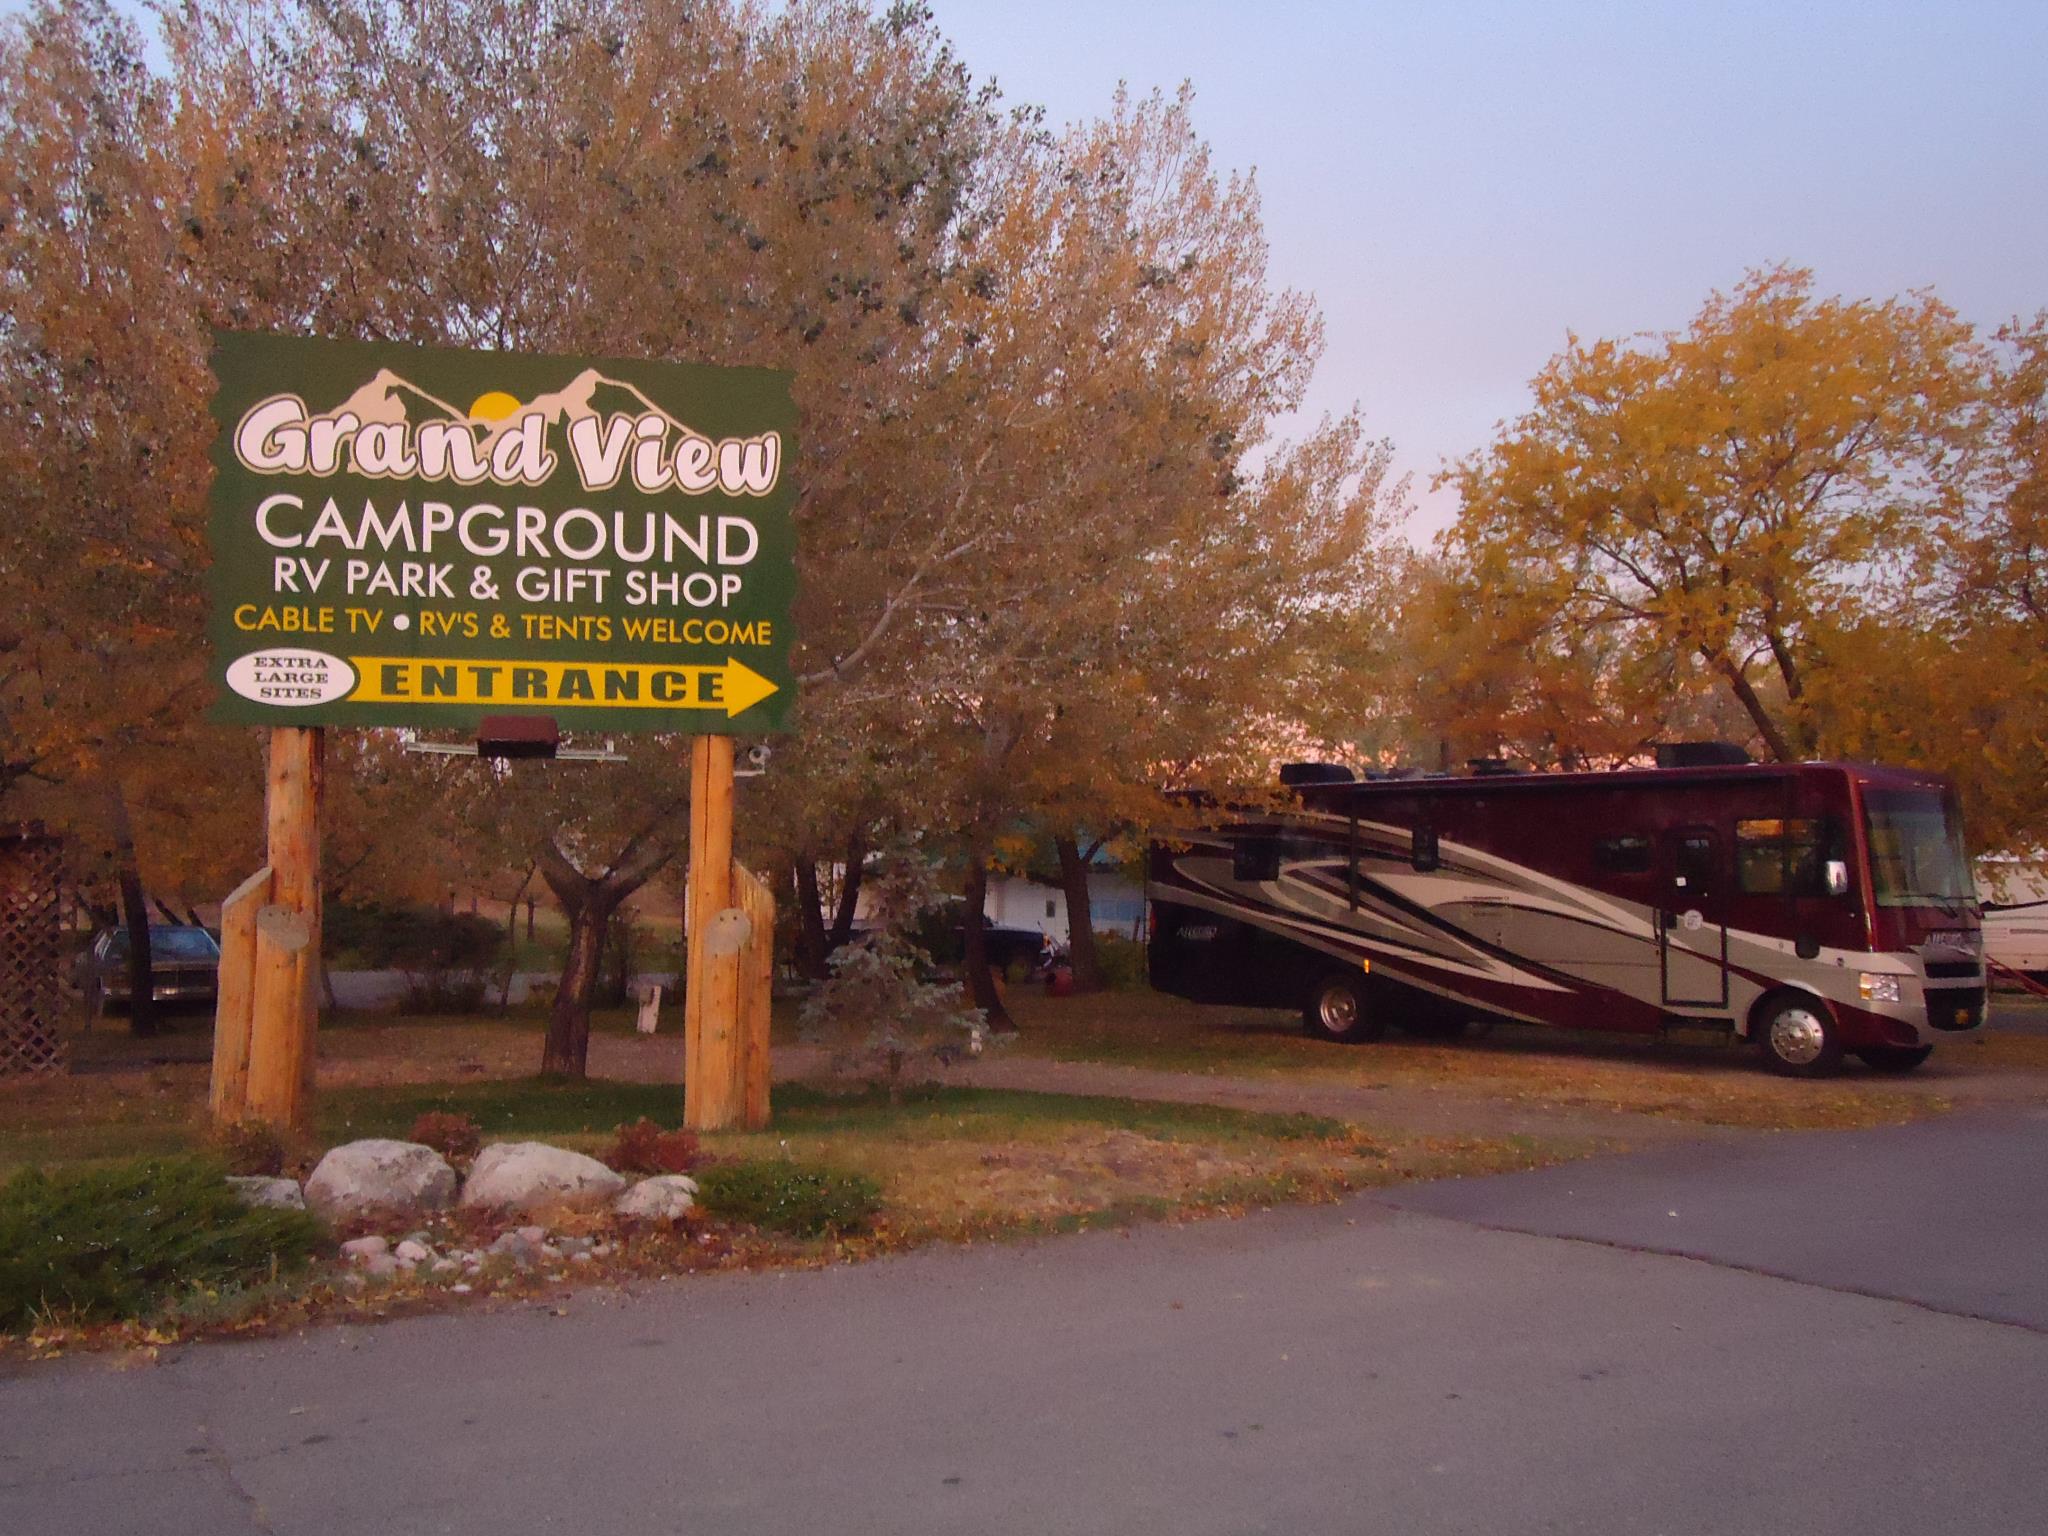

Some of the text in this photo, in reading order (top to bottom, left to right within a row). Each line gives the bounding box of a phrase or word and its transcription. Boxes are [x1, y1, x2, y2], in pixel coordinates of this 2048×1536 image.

[236, 396, 780, 495] Grand View
[255, 493, 759, 566] CAMPGROUND
[274, 556, 742, 608] RV PARK & GIFT SHOP
[233, 603, 772, 646] CABLE TV RV'S & TENTS WELCOME
[253, 656, 329, 670] EXTRA
[254, 671, 329, 685] LARGE
[380, 663, 725, 703] ENTRANCE
[260, 687, 322, 700] SITES
